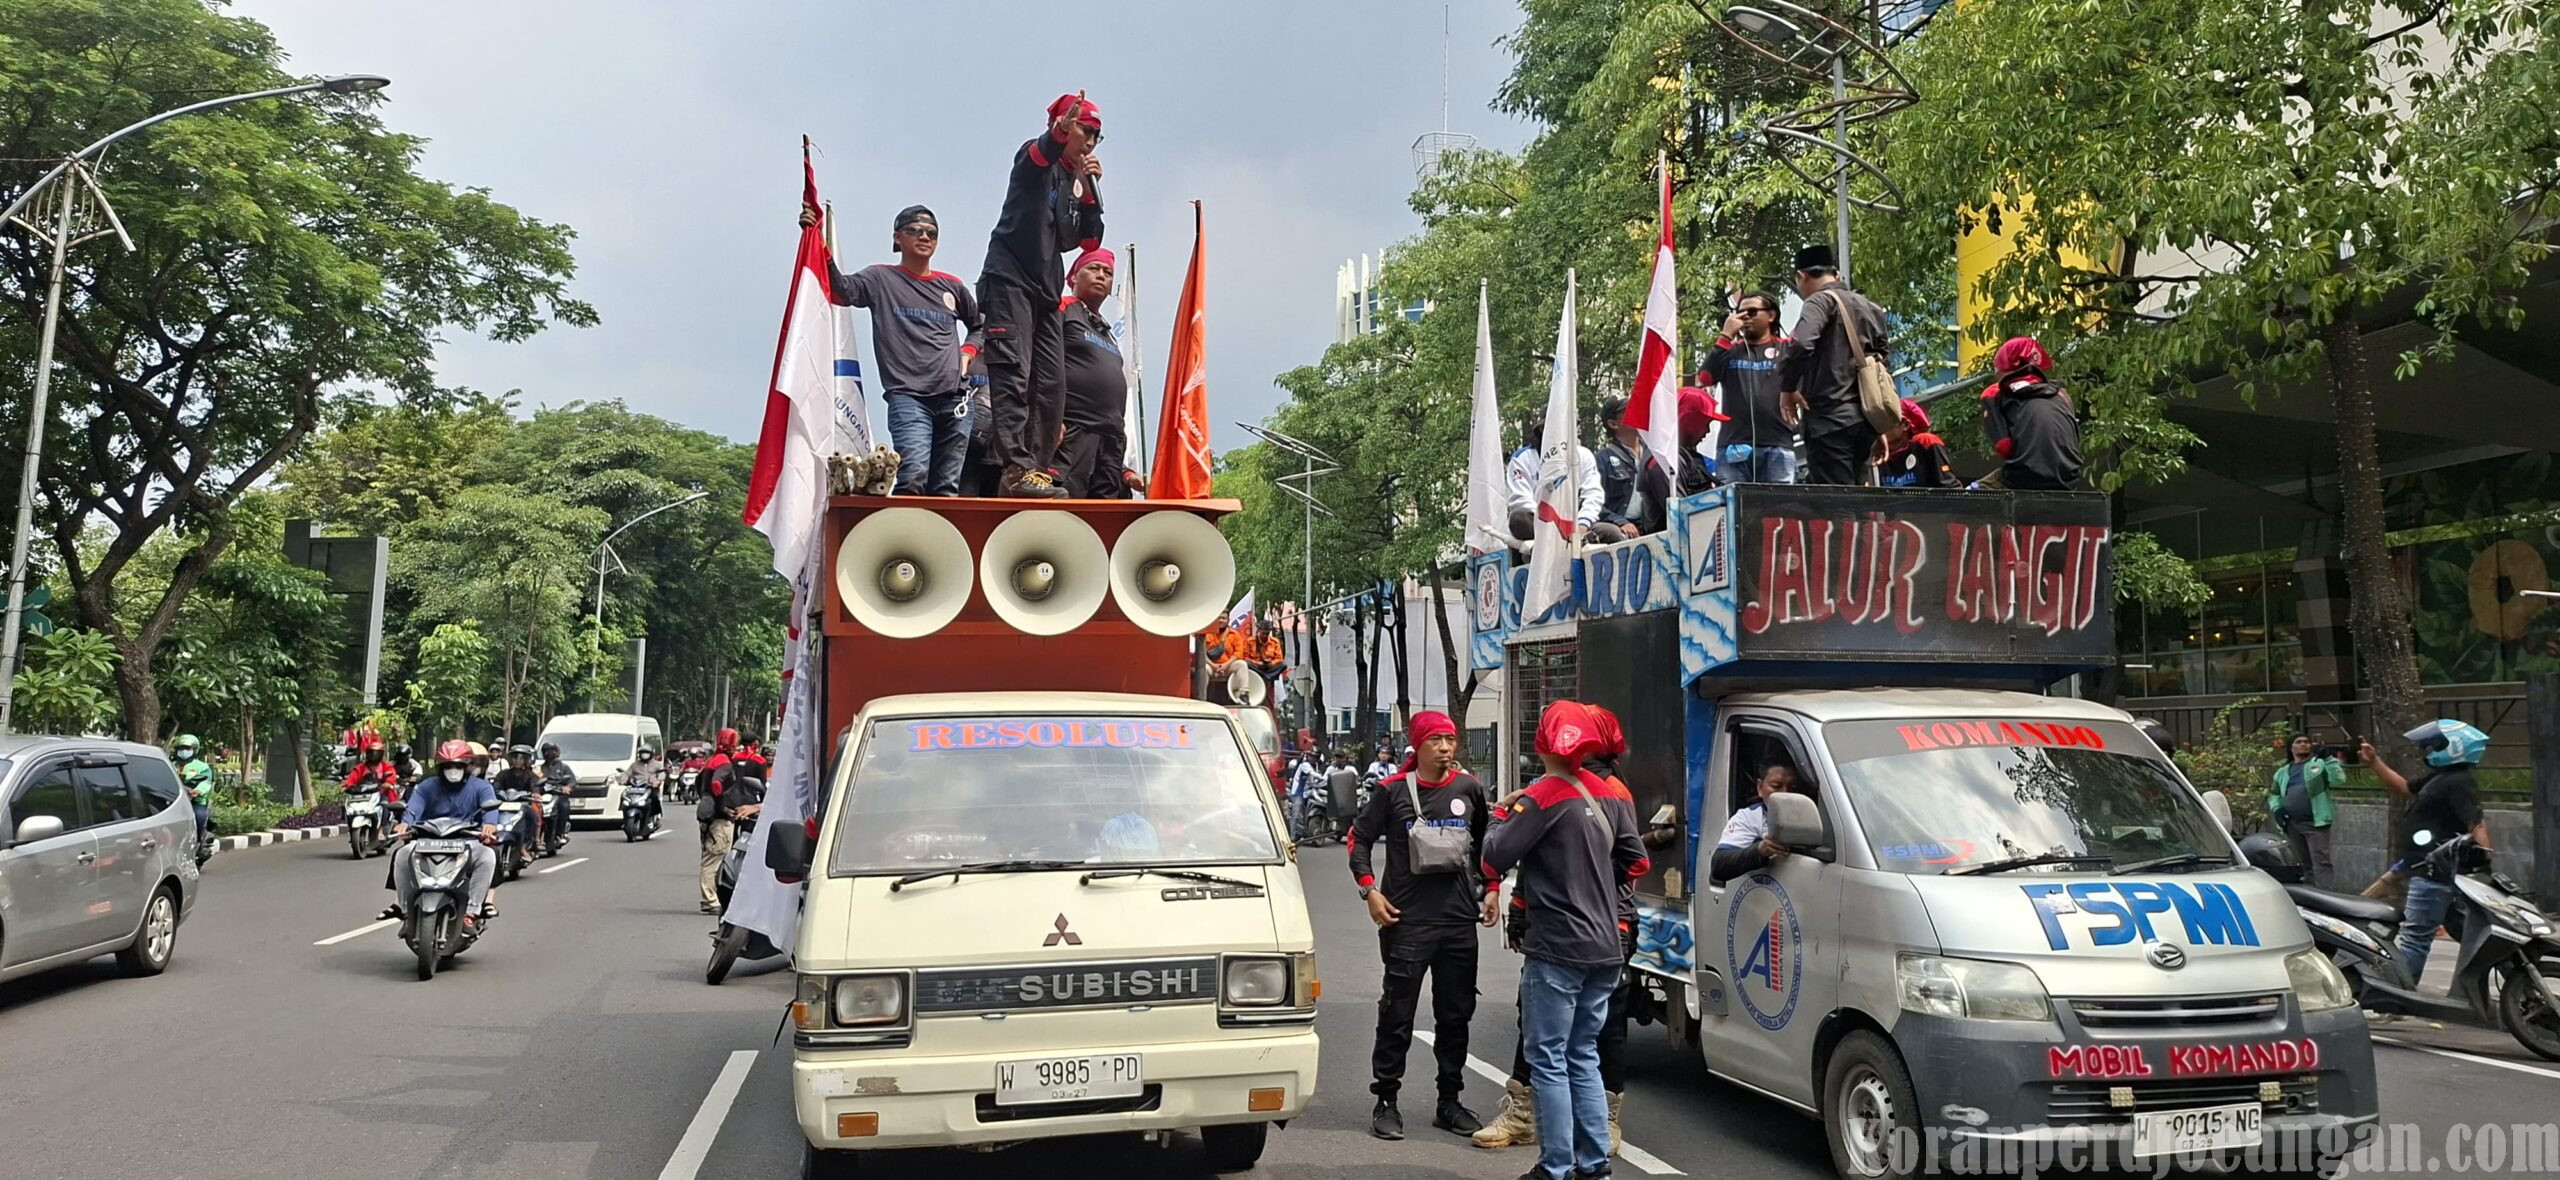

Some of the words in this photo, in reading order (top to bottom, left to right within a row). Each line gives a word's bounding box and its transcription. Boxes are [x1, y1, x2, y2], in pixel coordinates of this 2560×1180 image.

[1743, 517, 1926, 634] JALUR
[1946, 523, 2108, 637] LANGIT
[909, 721, 1196, 751] RESOLUSI
[1897, 721, 2105, 750] KOMANDO
[1882, 842, 1946, 858] FSPMI
[2020, 883, 2260, 950] FSPMI
[1001, 1064, 1015, 1090] W
[1039, 1059, 1090, 1087] 9985
[1113, 1057, 1138, 1083] PD
[2050, 1045, 2152, 1077] MOBIL
[2170, 1038, 2319, 1075] KOMANDO
[2137, 1117, 2149, 1141] W
[2172, 1111, 2222, 1138] 9015
[2236, 1108, 2260, 1133] NG
